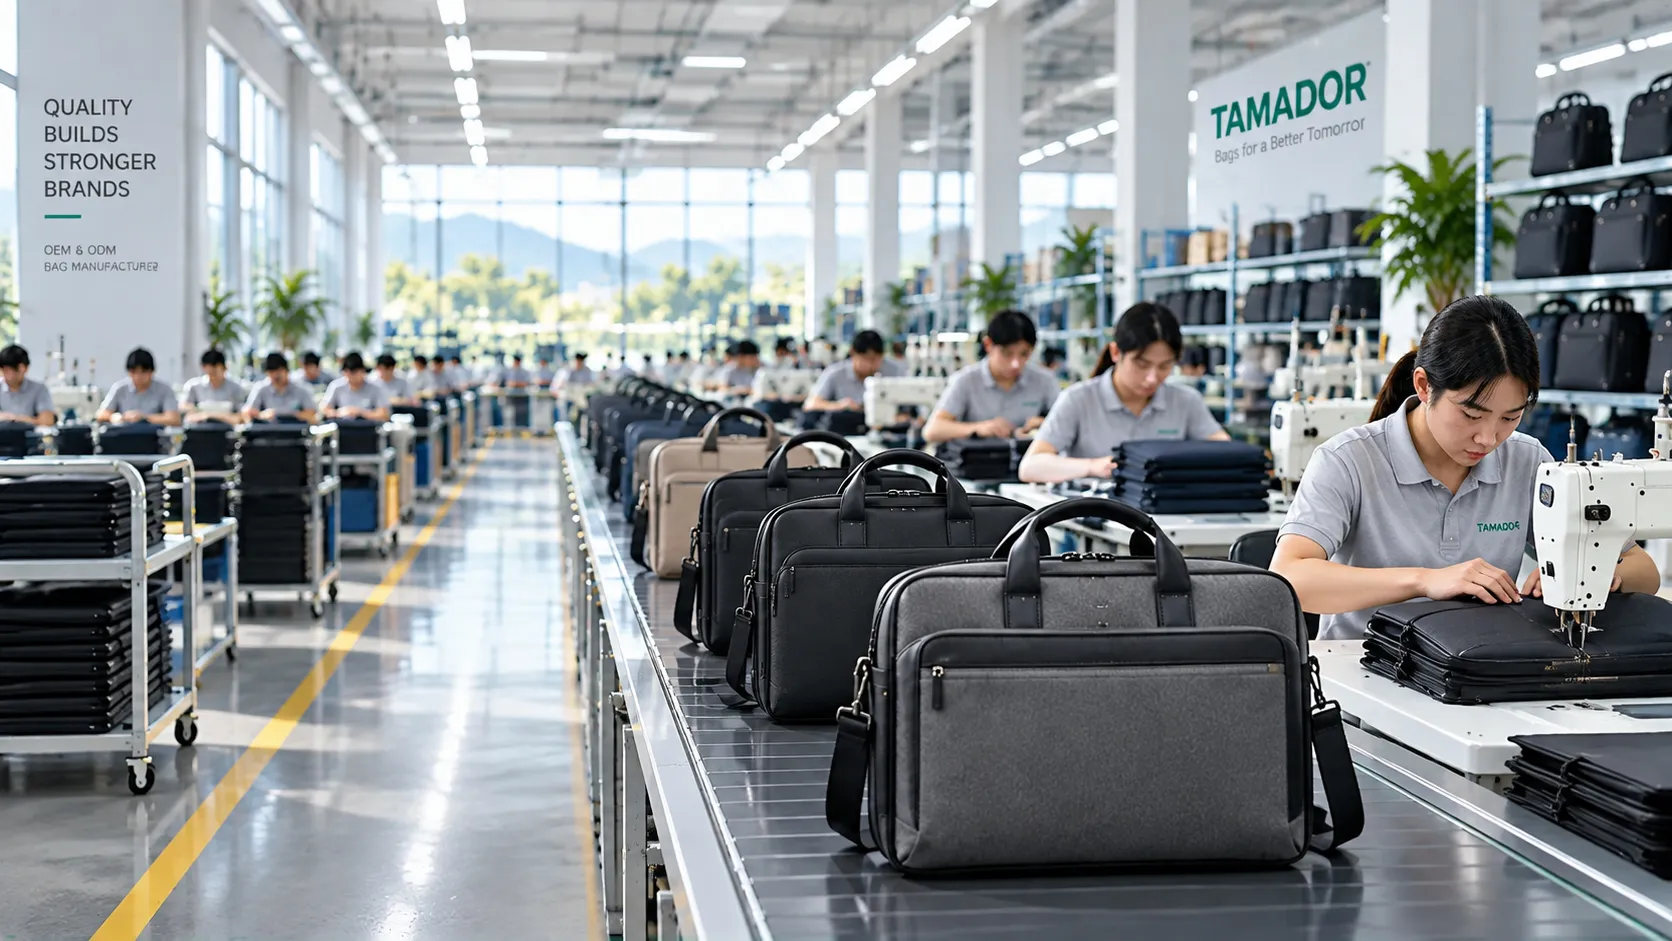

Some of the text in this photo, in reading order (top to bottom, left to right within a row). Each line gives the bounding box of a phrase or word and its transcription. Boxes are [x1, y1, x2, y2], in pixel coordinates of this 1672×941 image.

[43, 98, 133, 118] QUALITY
[1210, 61, 1367, 140] TAMADOR
[44, 125, 119, 143] BUILDS
[1214, 149, 1240, 165] Bags
[1242, 142, 1258, 157] for
[1260, 141, 1267, 153] a
[1270, 131, 1305, 151] Better
[43, 152, 157, 171] STRONGER
[44, 180, 130, 198] BRANDS
[43, 244, 117, 256] OEM & ODM
[44, 261, 68, 272] BAG
